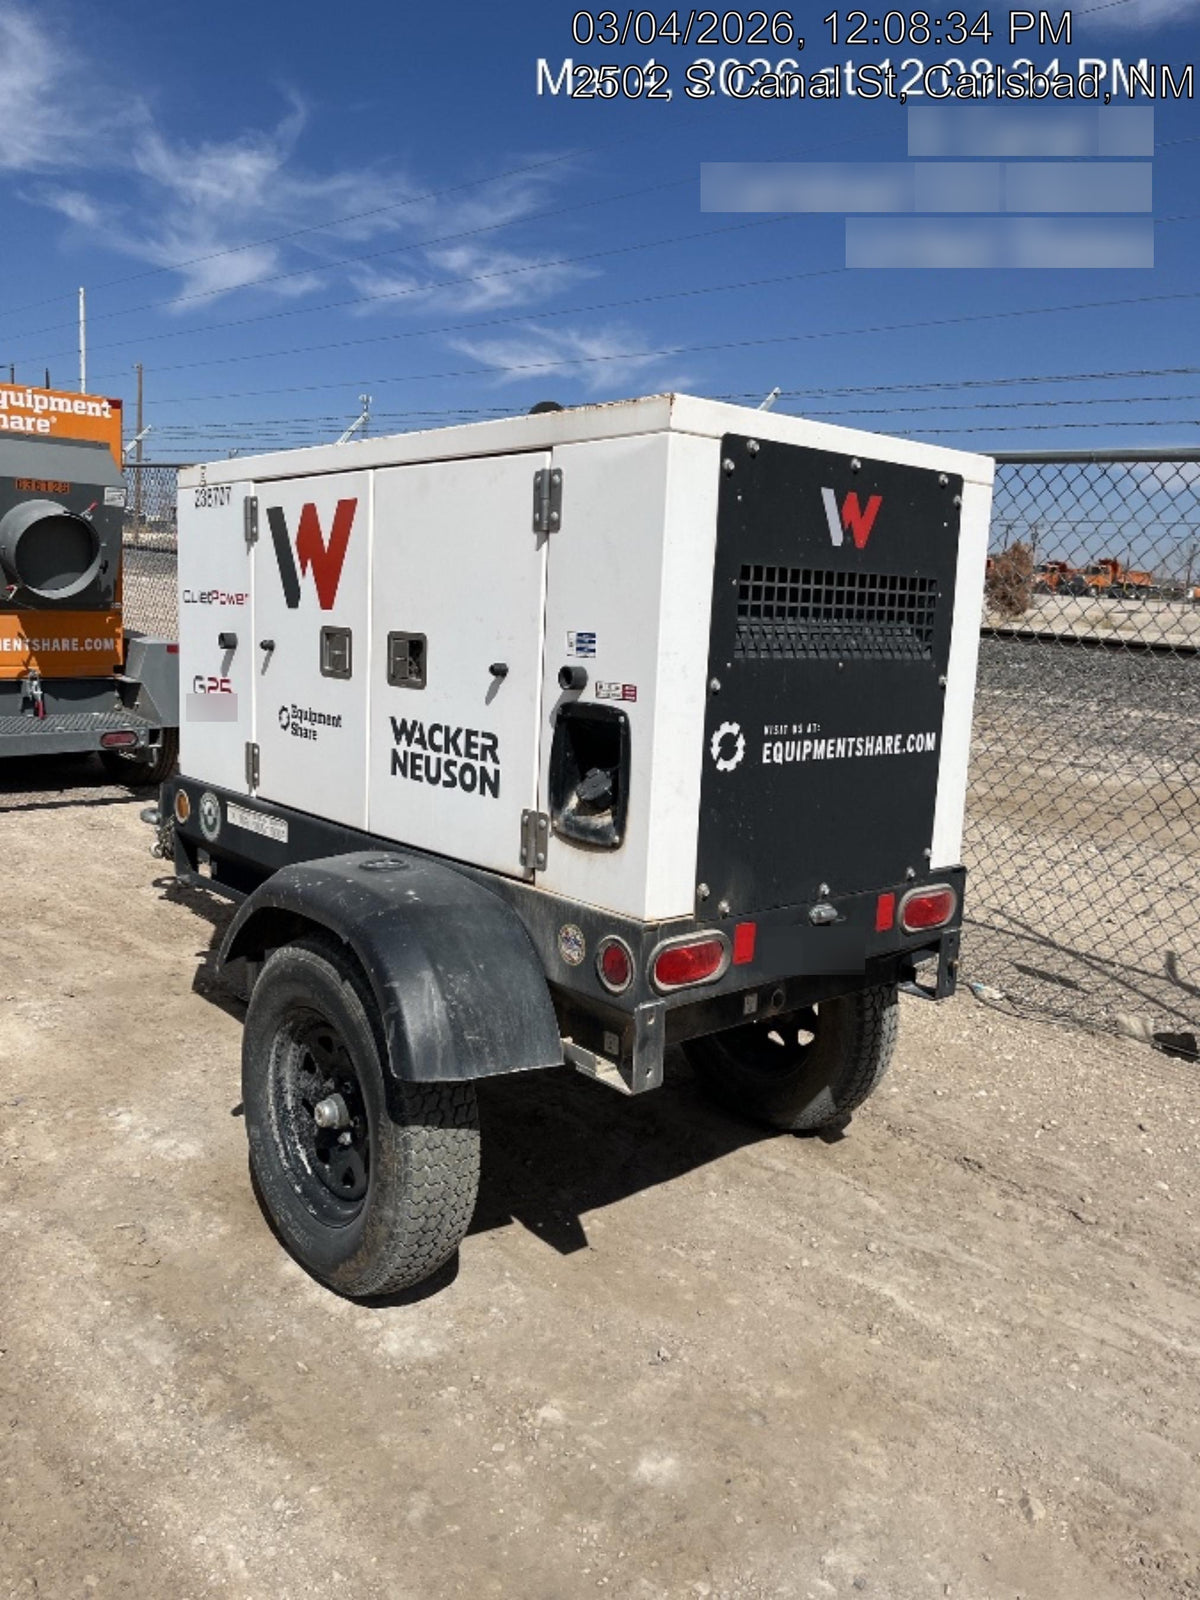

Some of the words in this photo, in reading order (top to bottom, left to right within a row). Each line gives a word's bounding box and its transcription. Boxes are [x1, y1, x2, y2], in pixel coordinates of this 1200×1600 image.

[0, 637, 115, 652] ENTSHARE.COM
[290, 703, 343, 728] Equipment
[290, 721, 318, 741] Share
[389, 716, 500, 765] WACKER
[762, 731, 937, 765] EQUIPMENTSHARE.COM
[390, 748, 500, 799] NEUSON
